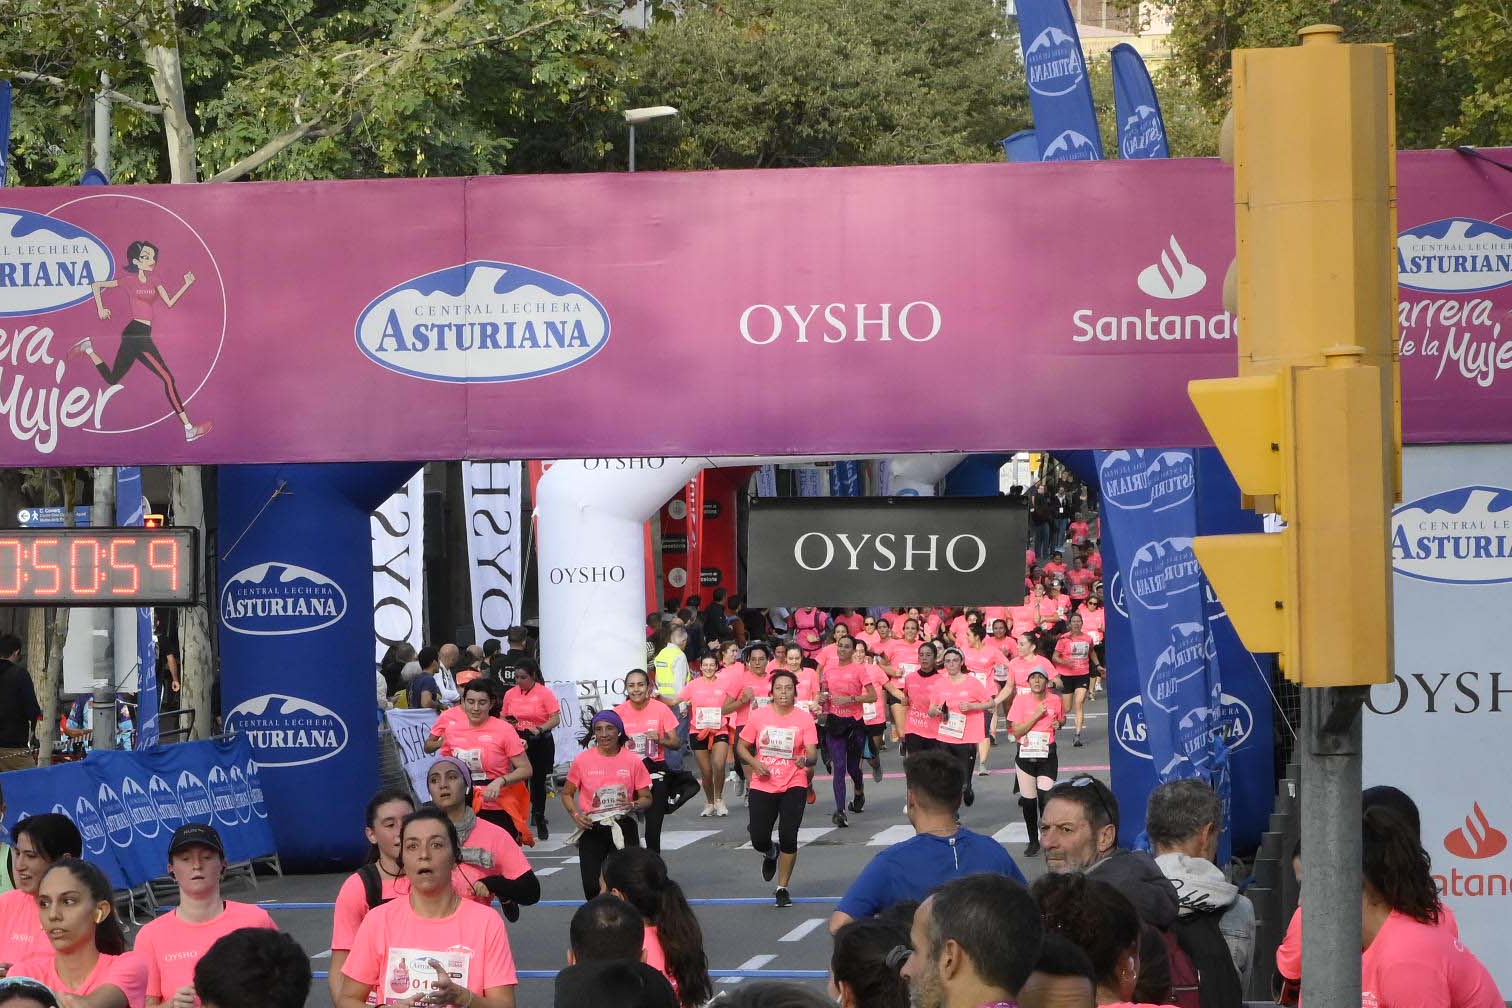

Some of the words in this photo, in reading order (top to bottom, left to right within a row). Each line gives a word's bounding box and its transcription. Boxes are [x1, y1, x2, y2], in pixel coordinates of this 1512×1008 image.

[18, 244, 89, 255] LECHERA
[415, 304, 492, 316] CENTRAL
[501, 302, 582, 314] LECHERA
[375, 308, 590, 352] ASTURIANA
[739, 301, 942, 344] OYSHO
[1418, 520, 1484, 532] CENTRAL
[795, 531, 987, 574] OYSHO
[550, 565, 625, 585] OYSHO
[237, 587, 280, 596] CENTRAL
[284, 586, 333, 595] LECHERA
[225, 592, 338, 619] ASTURIANA
[285, 719, 333, 727] LECHERA
